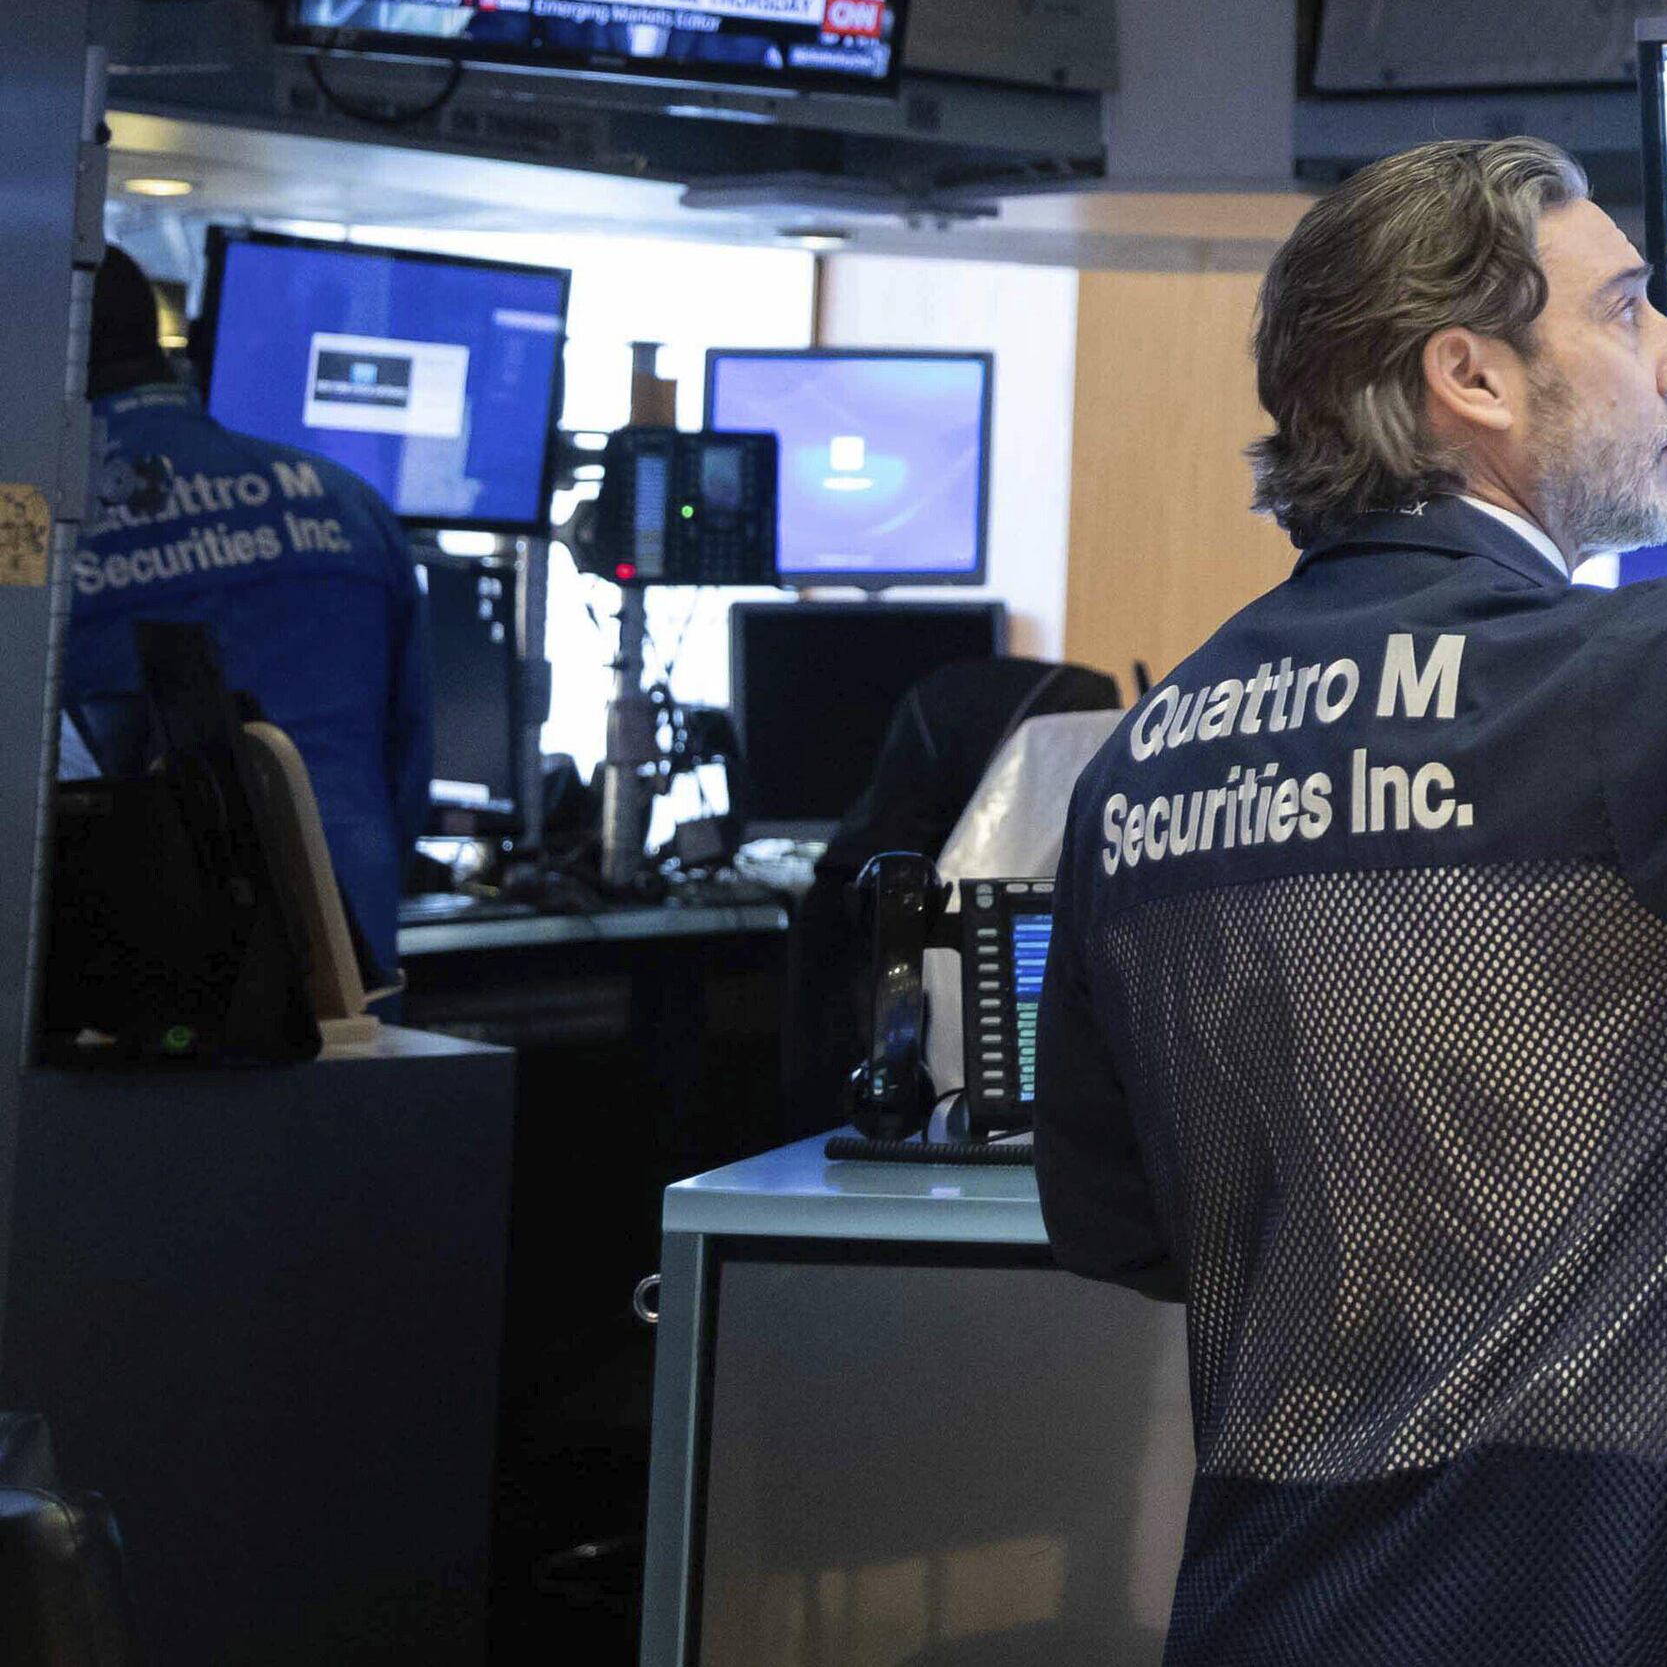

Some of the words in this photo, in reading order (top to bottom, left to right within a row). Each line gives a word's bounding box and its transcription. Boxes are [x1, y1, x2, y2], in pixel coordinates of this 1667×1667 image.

[1129, 655, 1360, 762] Quattro
[1375, 633, 1467, 719] M
[1102, 762, 1333, 876] Securities
[1351, 747, 1474, 834] Inc.
